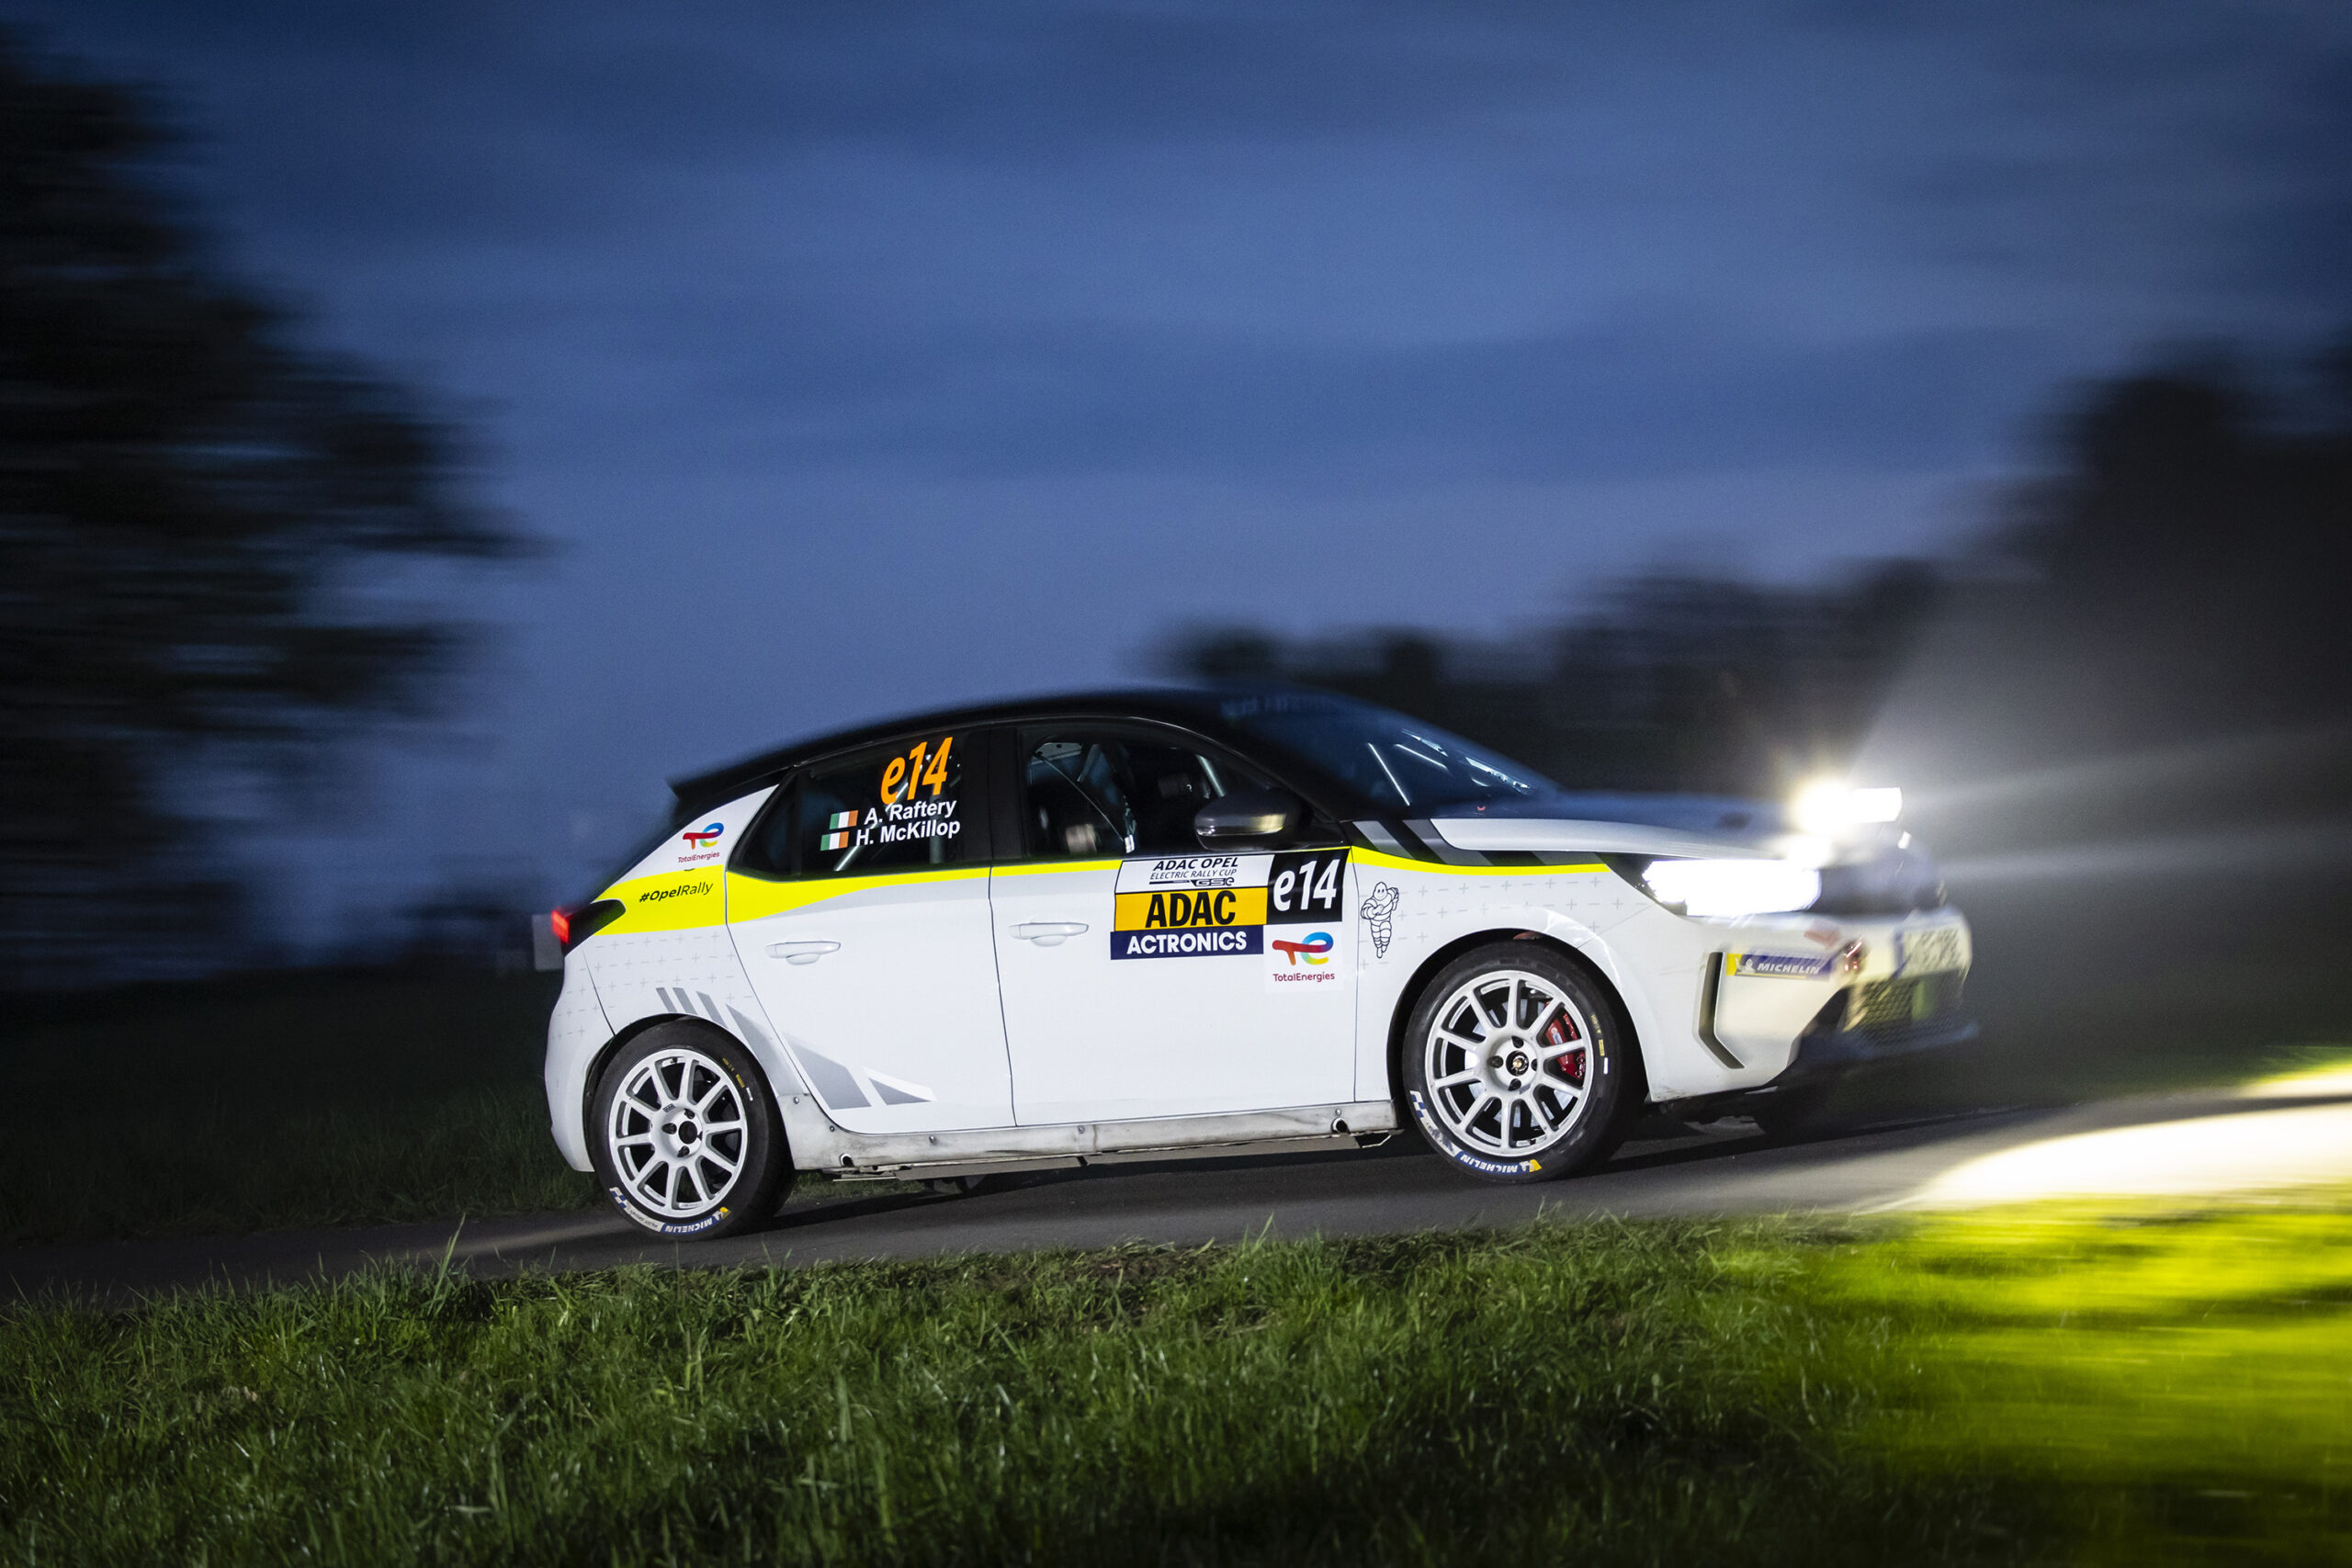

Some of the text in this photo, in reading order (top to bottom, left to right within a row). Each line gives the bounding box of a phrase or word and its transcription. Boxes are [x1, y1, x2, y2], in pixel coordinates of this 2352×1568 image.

[880, 737, 954, 805] e14
[865, 800, 957, 825] A. Raftery
[856, 819, 961, 846] H. McKillop
[677, 852, 720, 863] TotalEnergies
[1153, 857, 1238, 872] ADAC OPEL
[1149, 868, 1238, 880] ELECTRIC RALLY CUP
[639, 881, 714, 903] #OpelRally
[1272, 859, 1340, 911] e14
[1145, 890, 1237, 929] ADAC
[1126, 931, 1248, 955] ACTRONICS
[1272, 973, 1335, 983] TotalEnergies
[1757, 962, 1821, 975] MICHELIN
[1459, 1154, 1519, 1174] MICHELIN
[664, 1217, 713, 1233] MICHELIN
